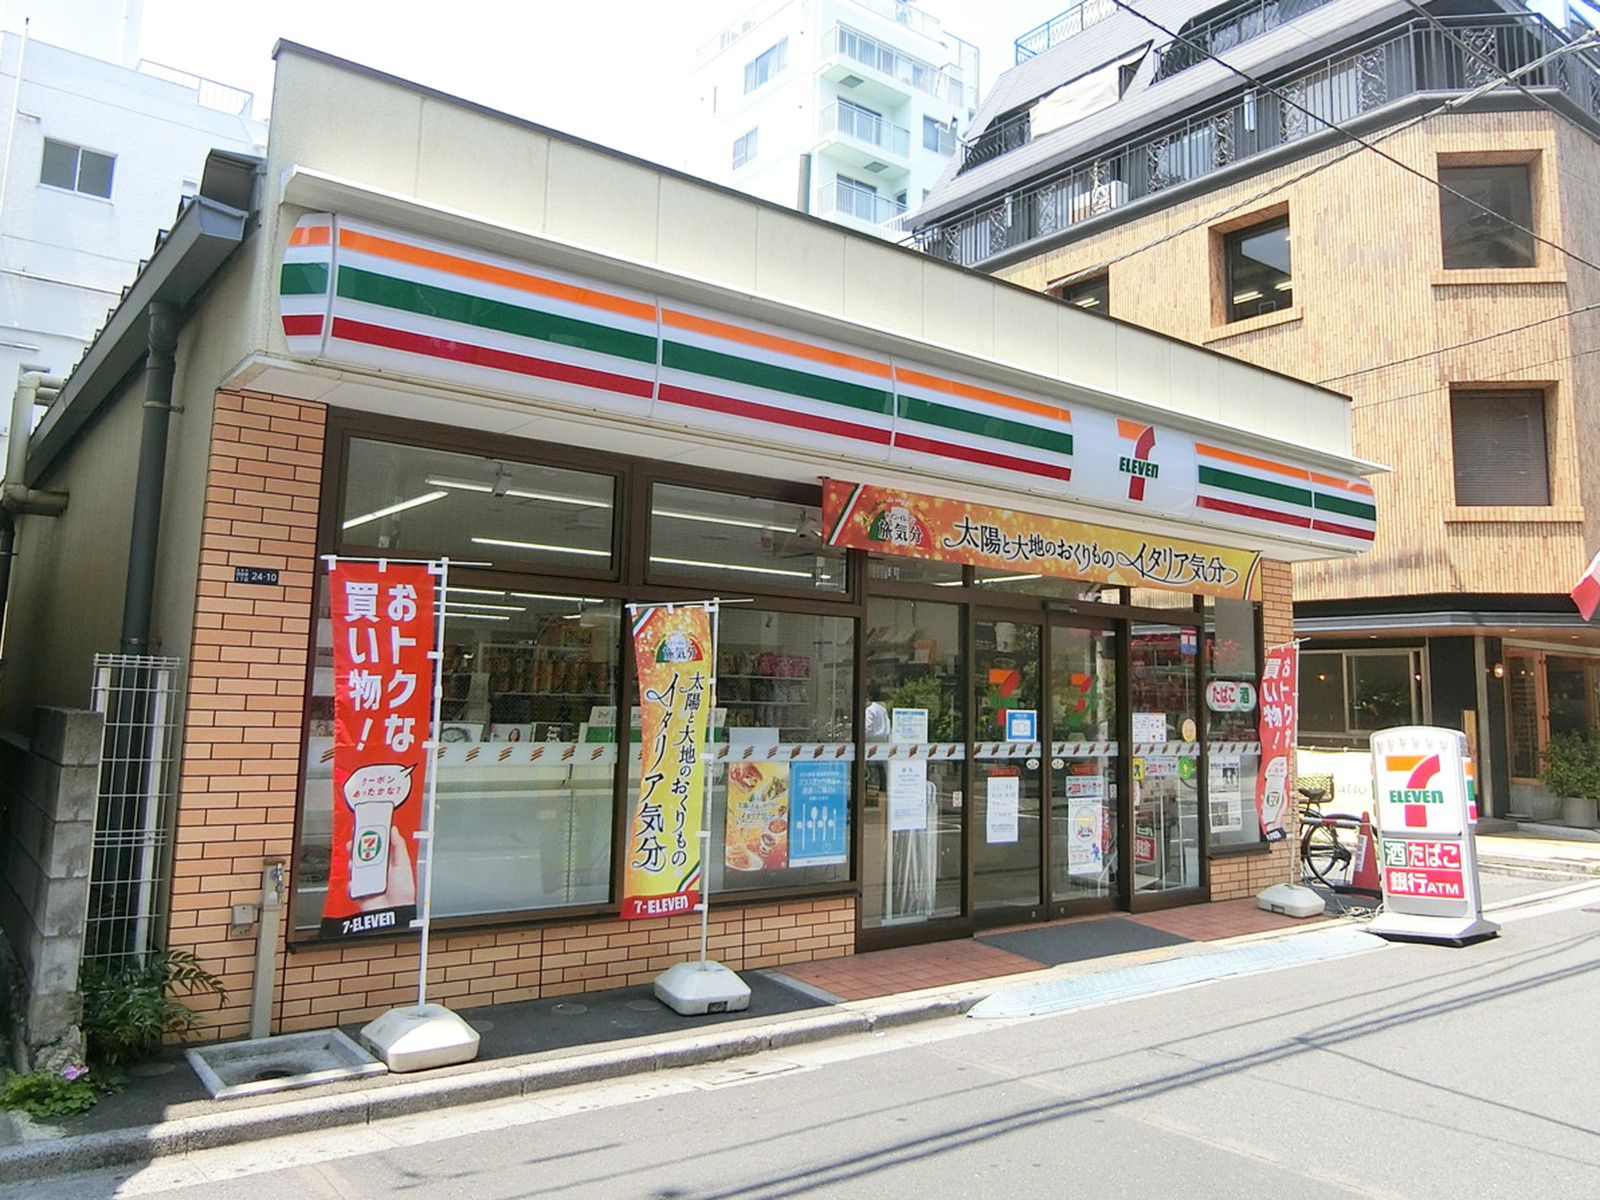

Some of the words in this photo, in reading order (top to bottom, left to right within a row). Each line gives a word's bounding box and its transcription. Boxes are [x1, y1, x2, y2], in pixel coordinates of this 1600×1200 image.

[879, 521, 921, 543] 旅気分
[251, 572, 277, 582] 24-10
[1117, 541, 1238, 587] イタリア気分
[344, 582, 382, 752] 買い物!
[384, 583, 418, 753] おトクな
[632, 672, 679, 873] イタリア気分
[671, 670, 706, 867] 太陽と大地のおくりもの
[1386, 841, 1406, 866] 酒
[1409, 843, 1460, 867] たばこ
